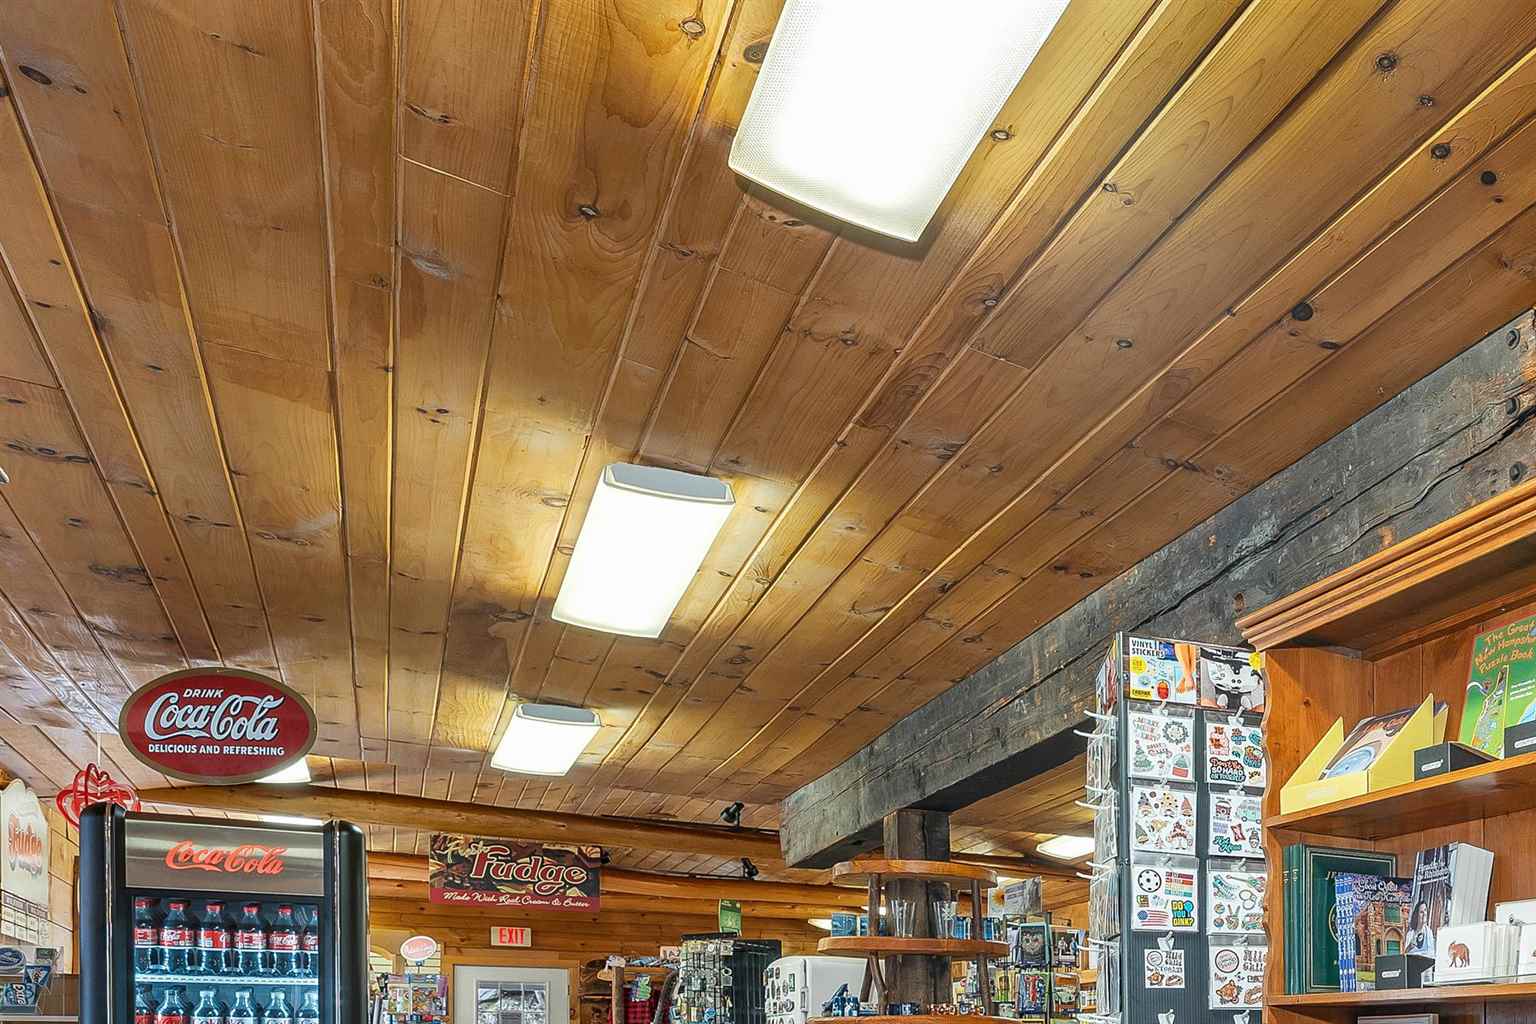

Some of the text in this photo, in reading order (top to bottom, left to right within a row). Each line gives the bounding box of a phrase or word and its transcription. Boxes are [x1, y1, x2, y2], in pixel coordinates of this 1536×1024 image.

[1131, 640, 1152, 649] VINYL
[1486, 632, 1504, 646] The
[1131, 647, 1165, 658] STICKERS
[183, 688, 224, 698] DRINK
[144, 692, 285, 742] Coca-Cola
[148, 744, 286, 756] DELICIOUS AND REFRESHING
[469, 844, 588, 896] Fudge
[498, 928, 525, 945] EXIT
